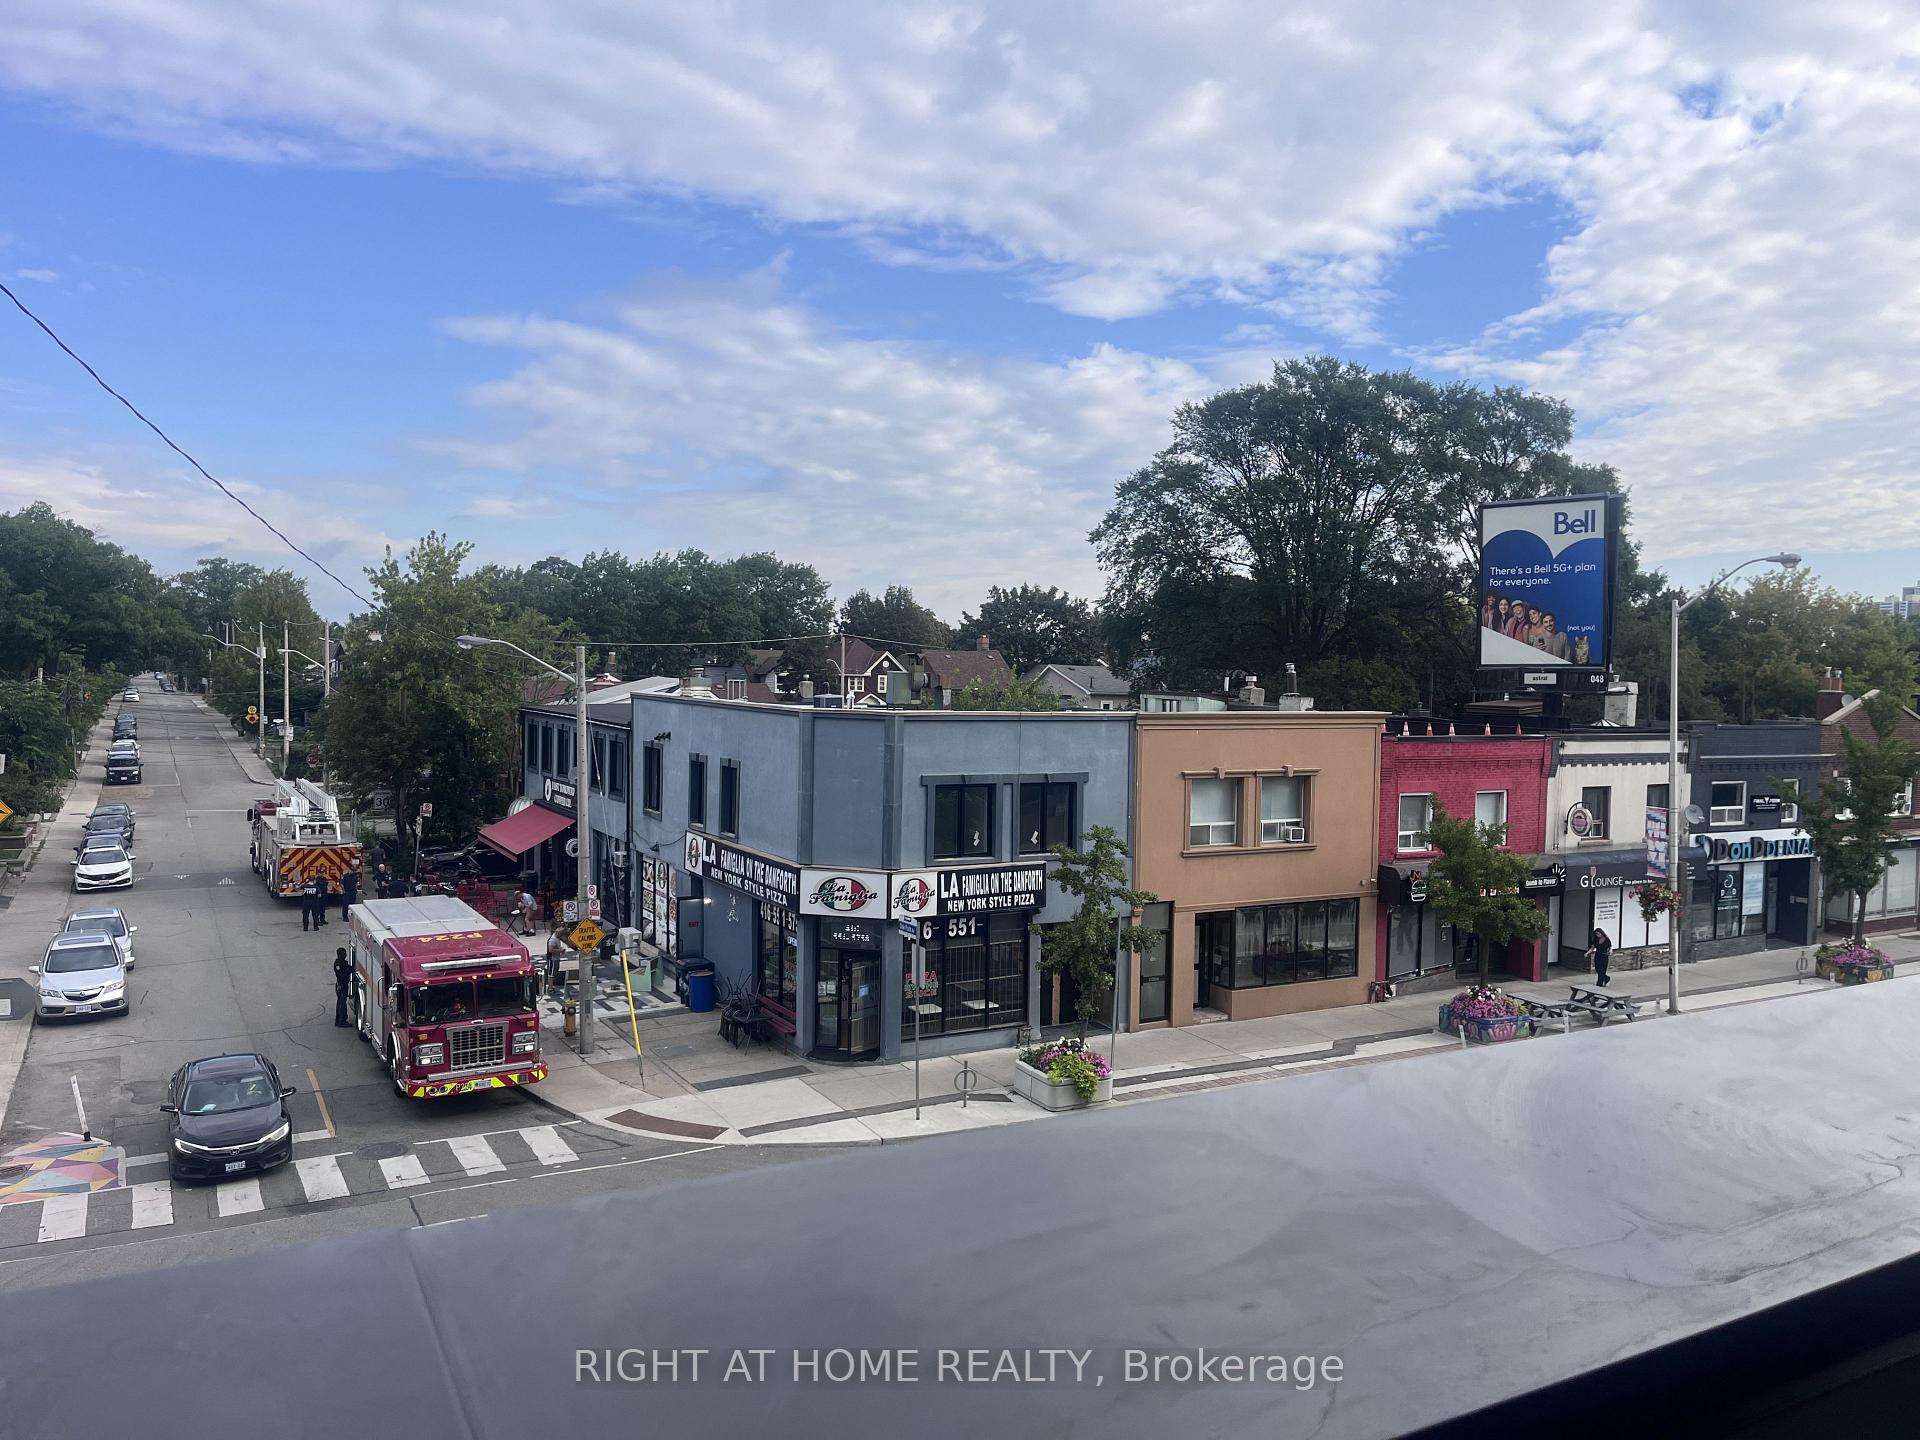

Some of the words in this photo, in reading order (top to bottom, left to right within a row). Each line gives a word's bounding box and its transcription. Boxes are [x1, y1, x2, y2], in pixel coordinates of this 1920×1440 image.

[1554, 510, 1596, 534] Bell
[1490, 566, 1523, 576] There's
[1534, 564, 1551, 574] Bell
[1553, 563, 1572, 573] 5G+
[1574, 562, 1596, 574] plan
[1489, 578, 1502, 587] for
[1505, 578, 1552, 588] everyone.
[1590, 675, 1604, 683] 048
[1766, 838, 1816, 857] DENTA
[308, 865, 336, 875] FIRE
[702, 840, 716, 864] LA
[721, 849, 744, 876] FAMIGLIA
[746, 858, 753, 878] ON
[754, 860, 765, 882] THE
[765, 865, 797, 895] DANFORTH
[710, 867, 722, 880] NEW
[724, 872, 742, 887] YORK
[744, 880, 764, 898] STYLE
[766, 887, 788, 907] PIZZA
[824, 882, 846, 893] La
[940, 872, 959, 898] LA
[962, 874, 989, 896] FAMIGLIA
[990, 872, 999, 894] ON
[1001, 872, 1012, 892] THE
[1013, 870, 1043, 892] DANFORTH
[1580, 875, 1589, 888] G
[1590, 870, 1623, 888] LOUNGE
[808, 890, 878, 905] Famiglia
[904, 883, 916, 894] La
[893, 890, 935, 909] Famiglia
[948, 899, 964, 912] NEW
[966, 898, 986, 911] YORK
[989, 896, 1011, 909] STYLE
[1014, 893, 1035, 906] PIZZA
